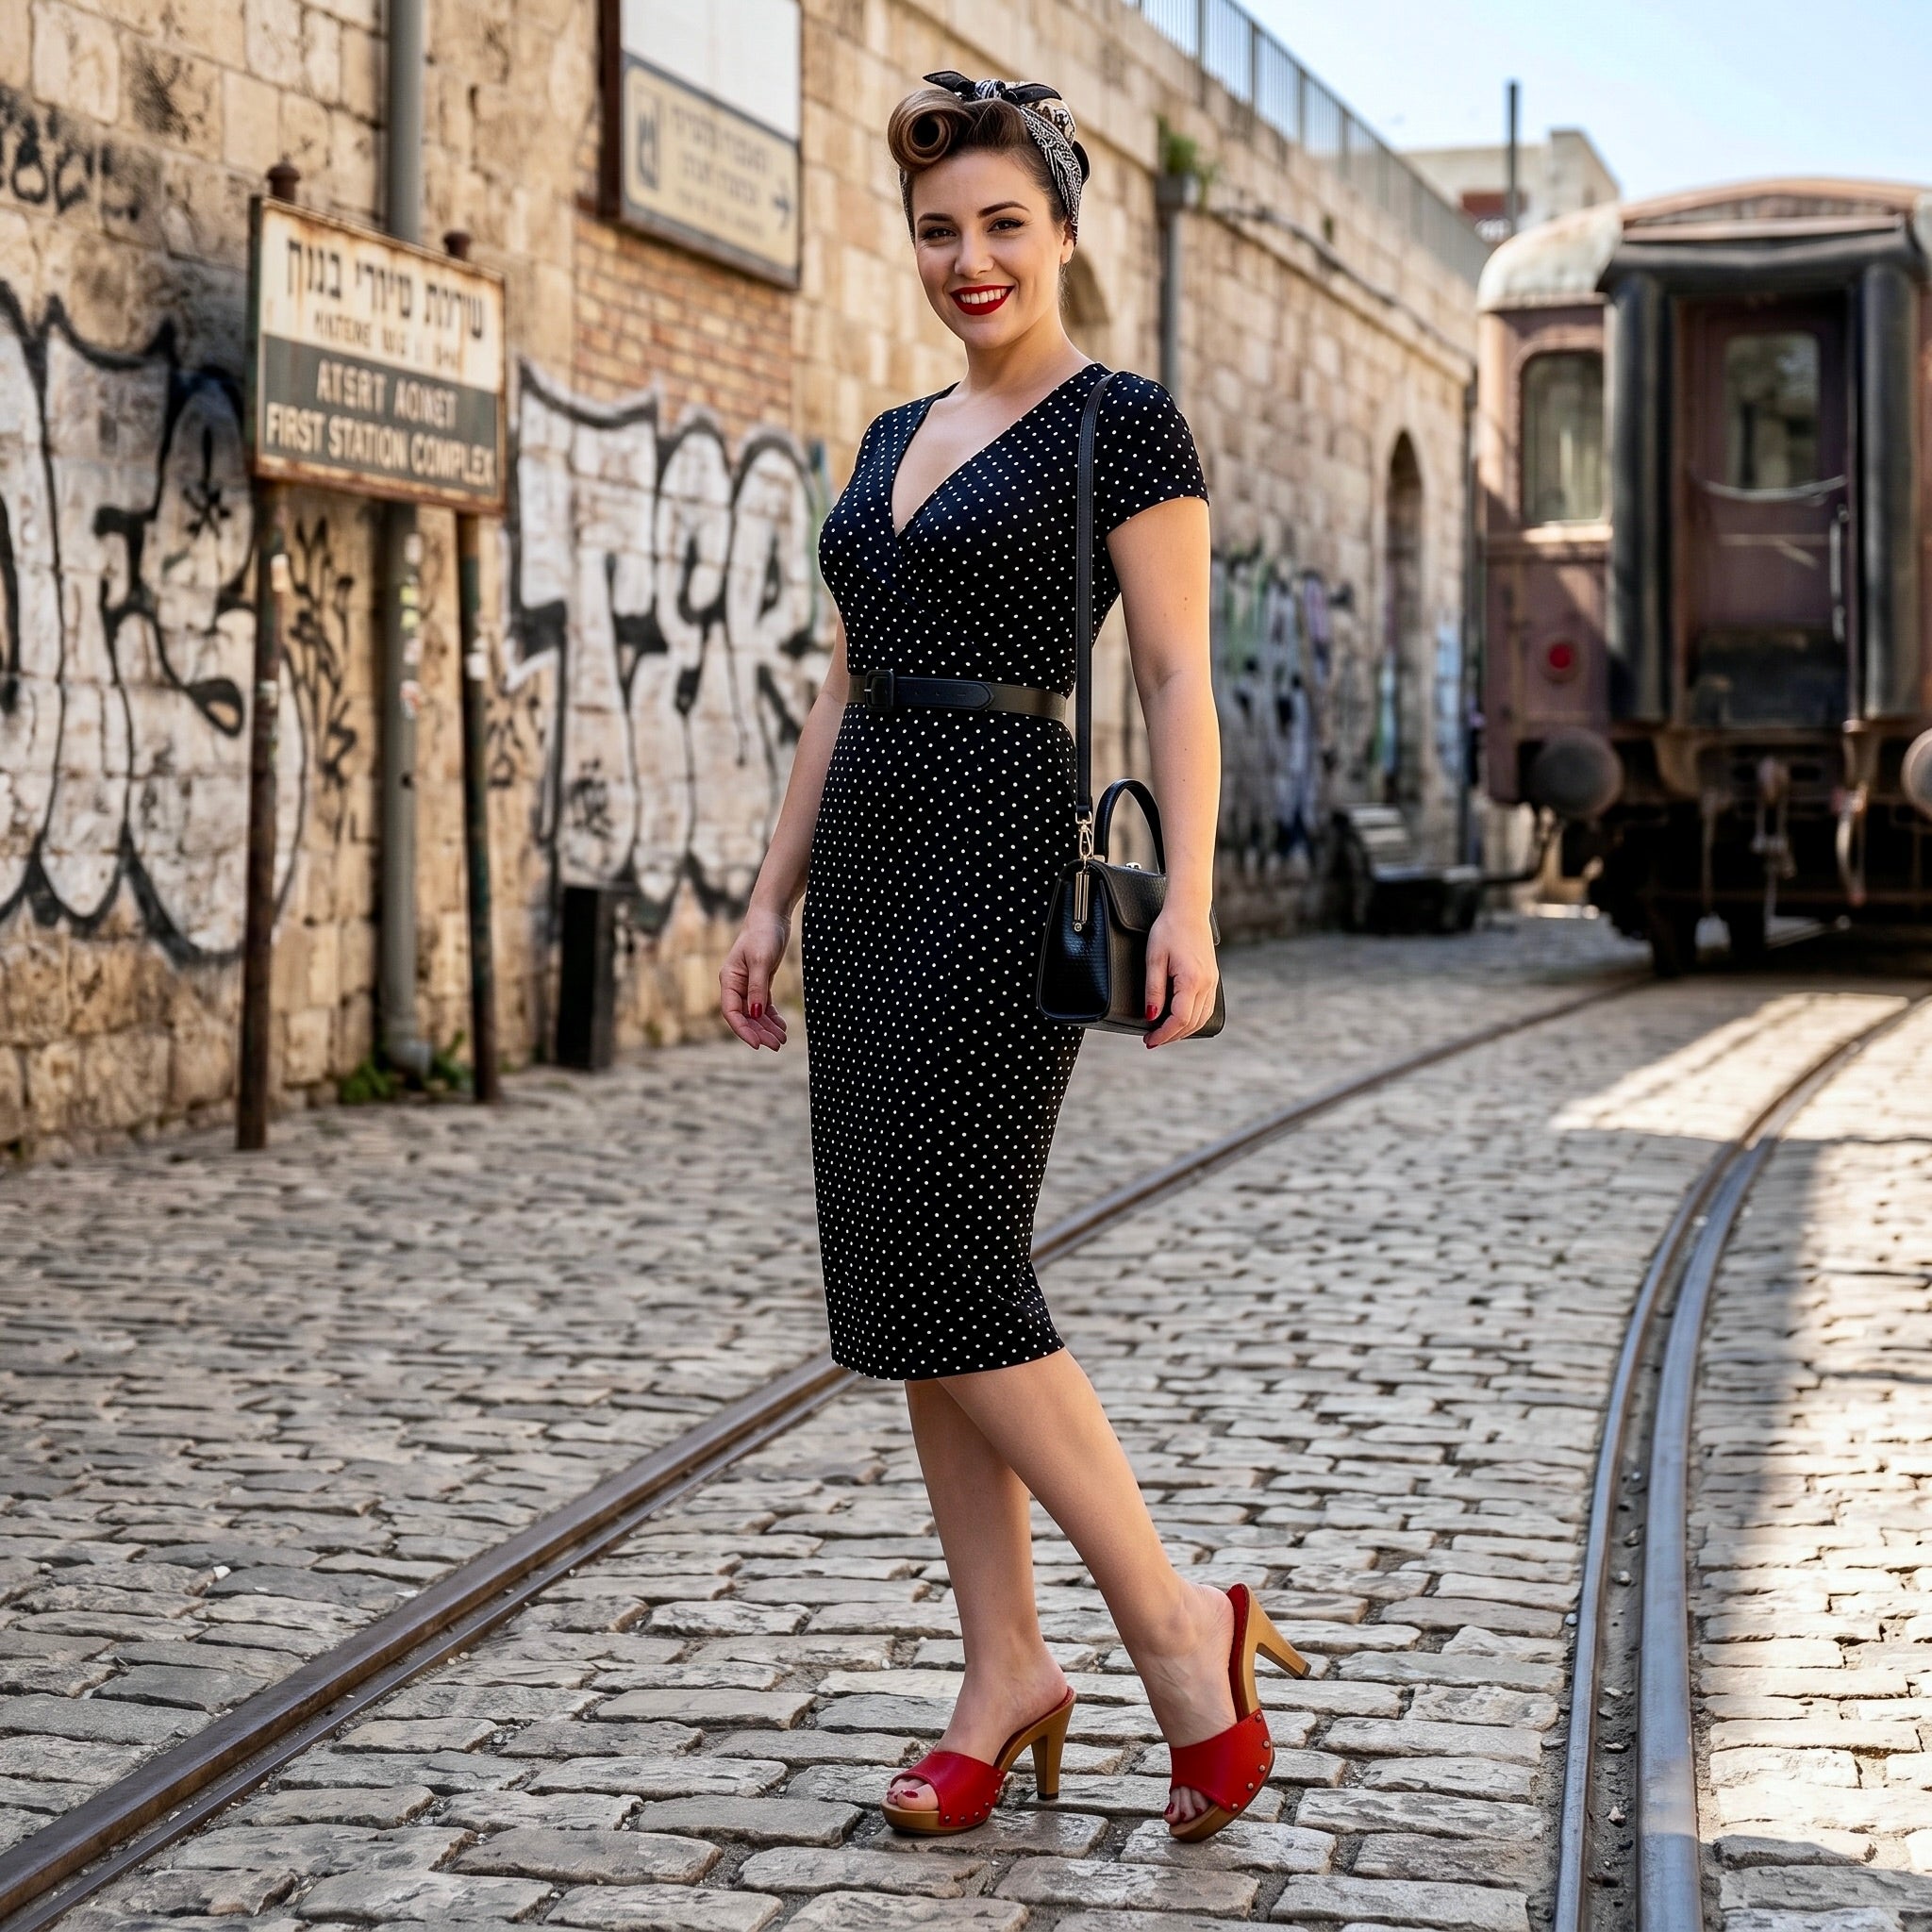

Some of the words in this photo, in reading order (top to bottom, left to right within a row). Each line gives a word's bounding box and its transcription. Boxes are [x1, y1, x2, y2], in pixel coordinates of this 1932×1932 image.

[267, 402, 326, 454] FIRST
[328, 415, 408, 470] STATION
[411, 432, 494, 486] COMPLEX
